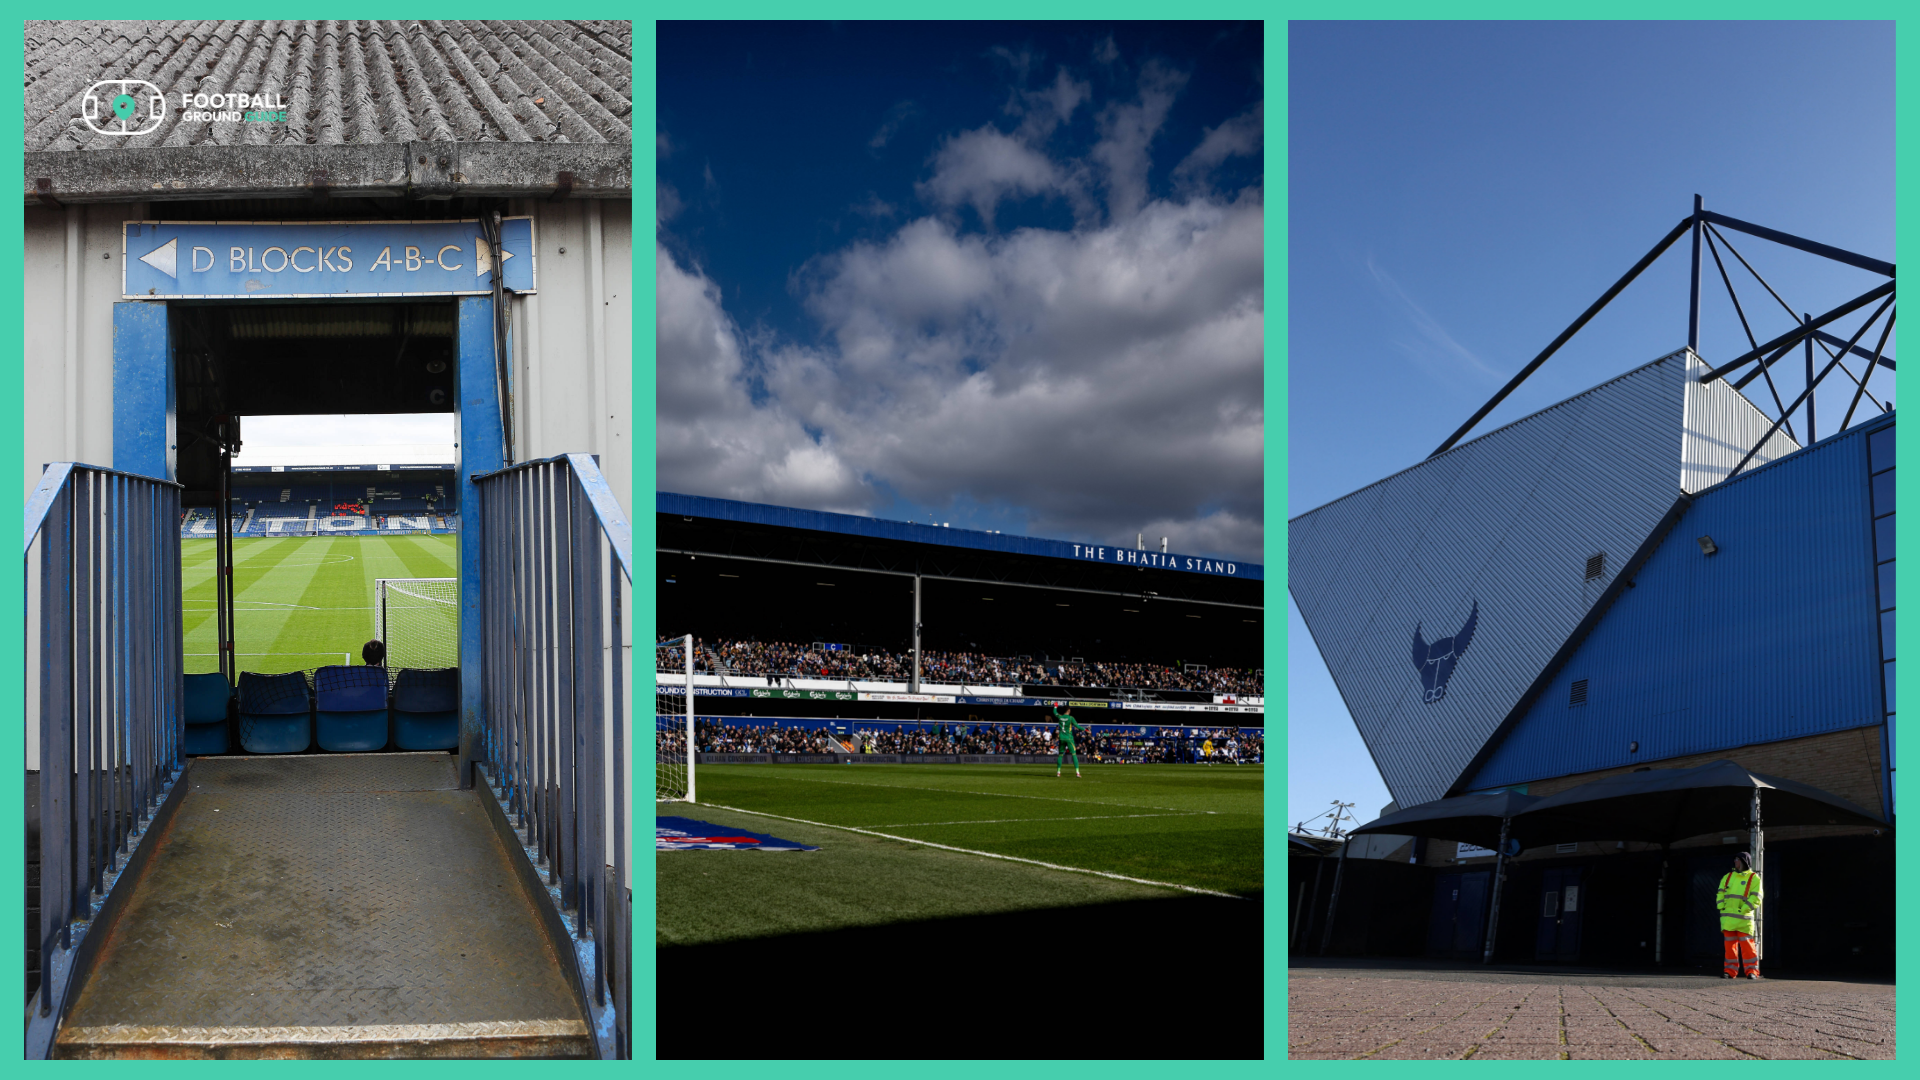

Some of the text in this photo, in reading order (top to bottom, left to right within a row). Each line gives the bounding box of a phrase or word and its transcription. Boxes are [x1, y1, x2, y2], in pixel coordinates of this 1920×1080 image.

[192, 244, 463, 273] D BLOCKS A-B-C
[1073, 544, 1236, 575] THE BHATIA STAND
[680, 687, 732, 696] CNSTRUCTION
